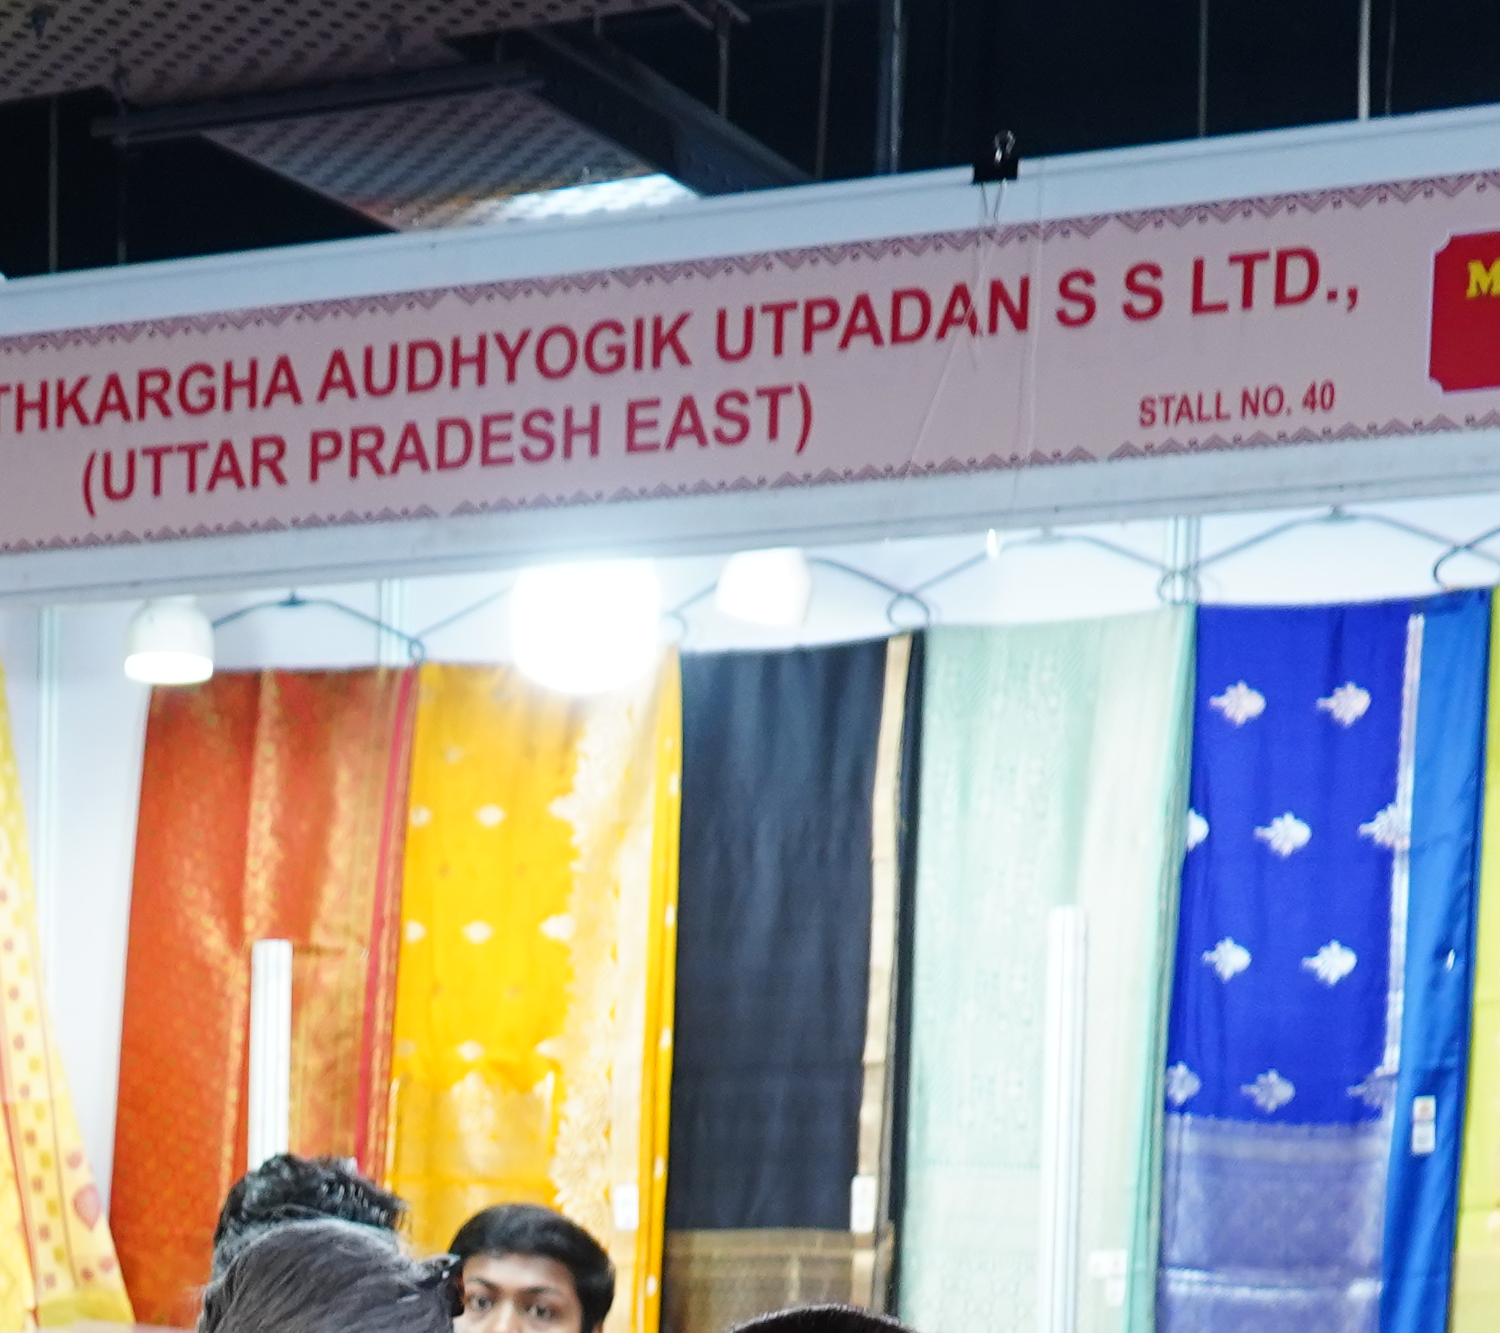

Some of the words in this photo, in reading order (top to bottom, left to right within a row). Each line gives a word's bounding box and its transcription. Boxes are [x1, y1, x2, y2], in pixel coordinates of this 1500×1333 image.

[317, 311, 693, 403] AUDHYOGIK
[715, 275, 1030, 363] UTPADAN
[1056, 267, 1097, 328] S
[1122, 261, 1164, 321] S
[1191, 244, 1359, 315] LTD.,
[82, 434, 289, 518] (UTTAR
[310, 403, 600, 483] PRADESH
[624, 382, 813, 455] EAST)
[1139, 390, 1231, 428] STALL
[1240, 384, 1292, 420] NO.
[1302, 379, 1336, 413] 40
